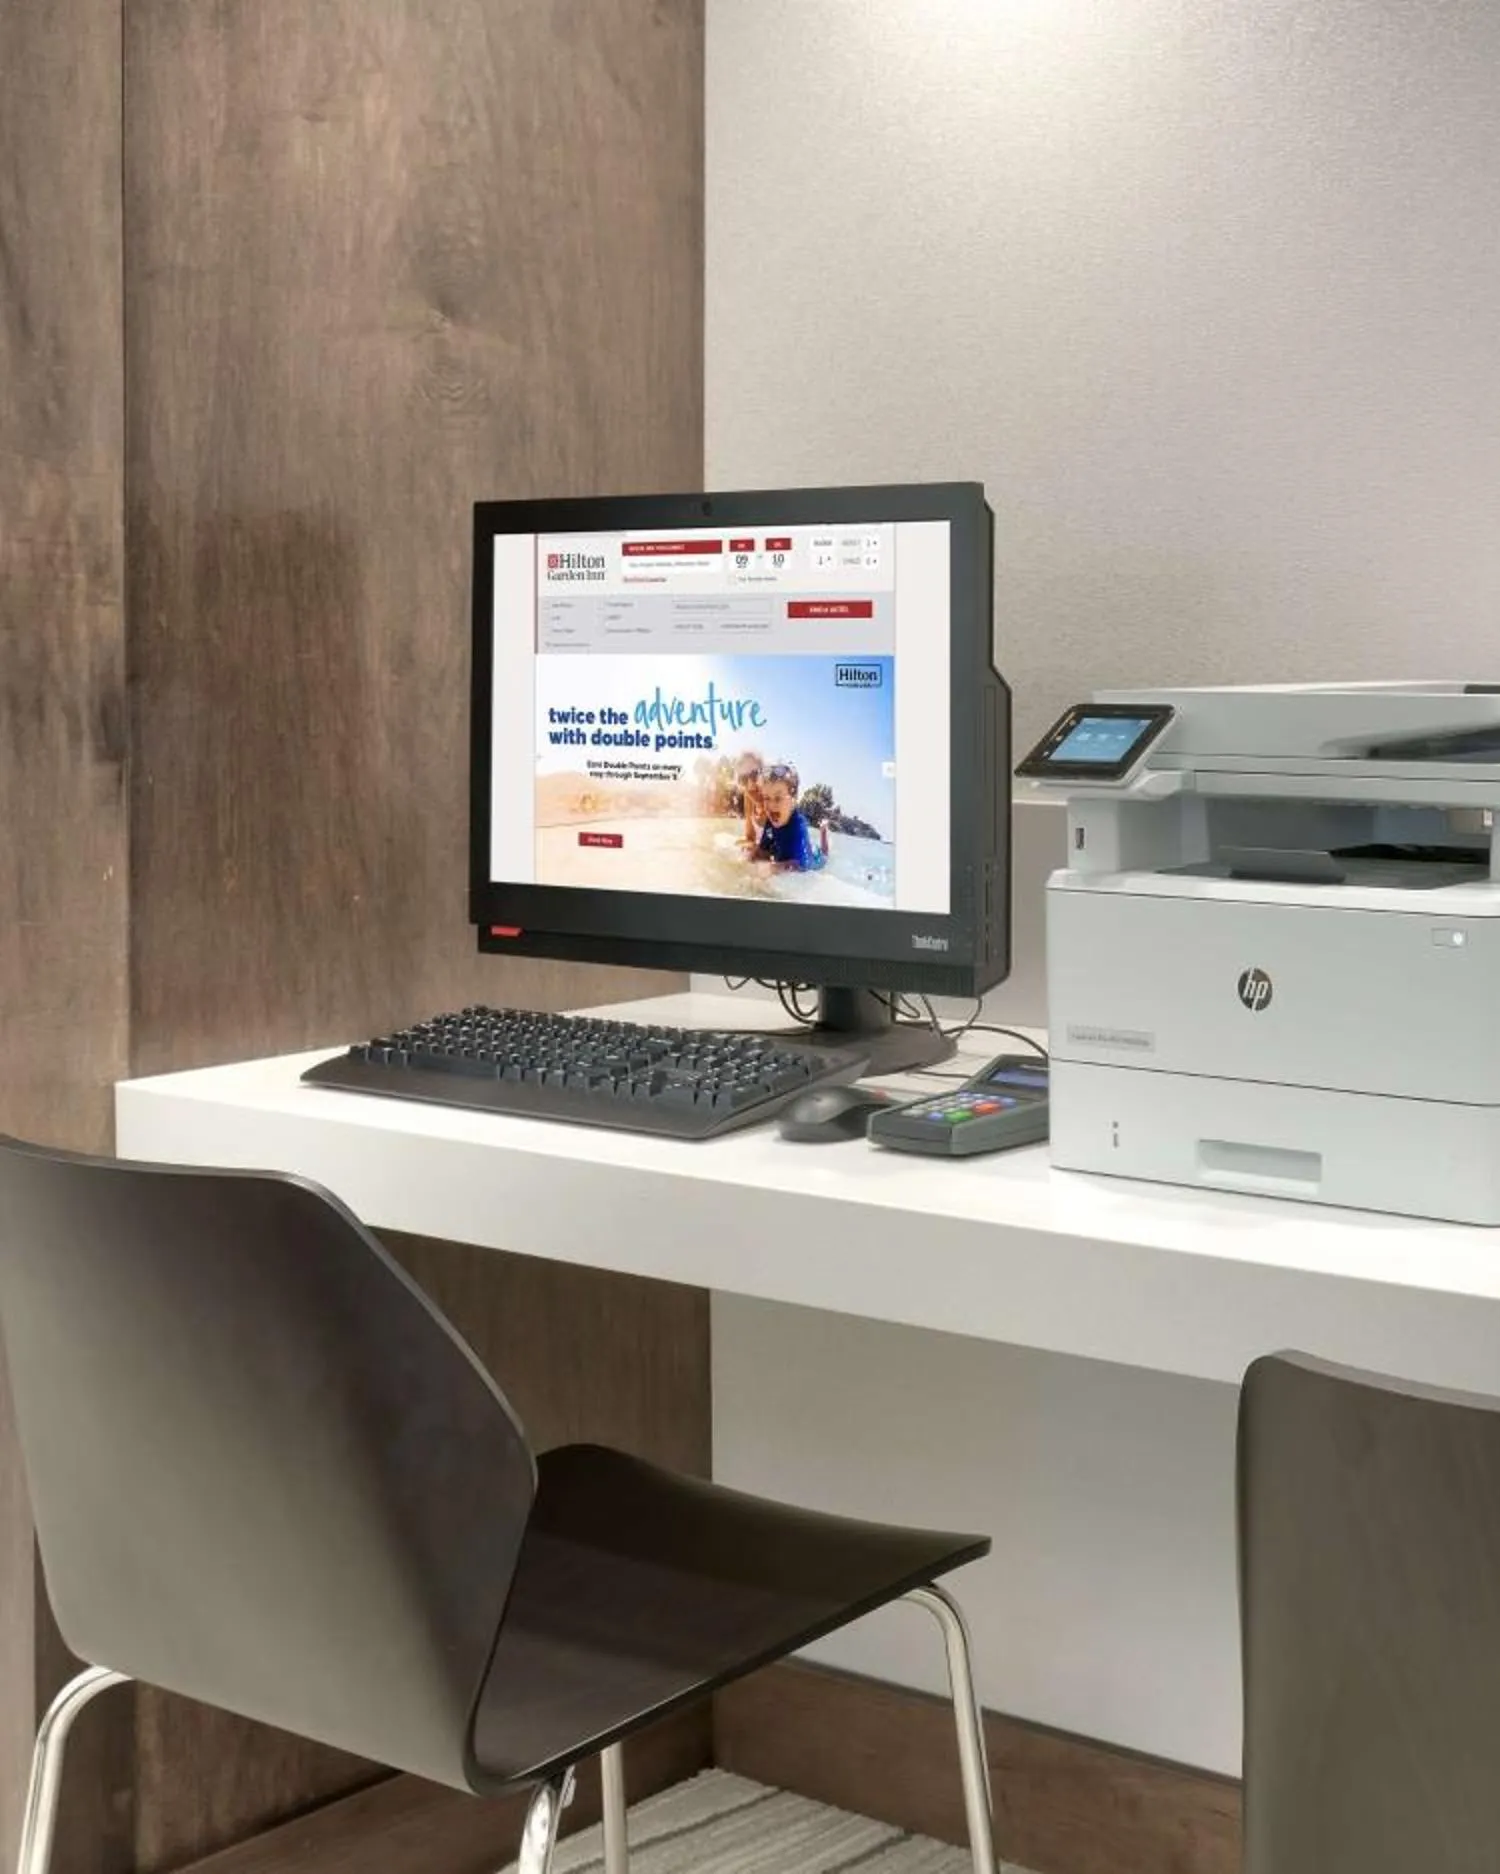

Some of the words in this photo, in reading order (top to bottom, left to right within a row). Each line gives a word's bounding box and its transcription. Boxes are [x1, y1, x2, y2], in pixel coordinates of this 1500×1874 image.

[559, 552, 605, 569] Hilton
[772, 553, 785, 564] 10
[839, 667, 877, 681] Hilton
[548, 707, 596, 725] twice
[600, 707, 629, 725] the
[633, 681, 768, 737] adventure
[549, 728, 587, 745] with
[590, 729, 650, 747] double
[655, 730, 713, 752] points
[1242, 968, 1270, 1011] hp
